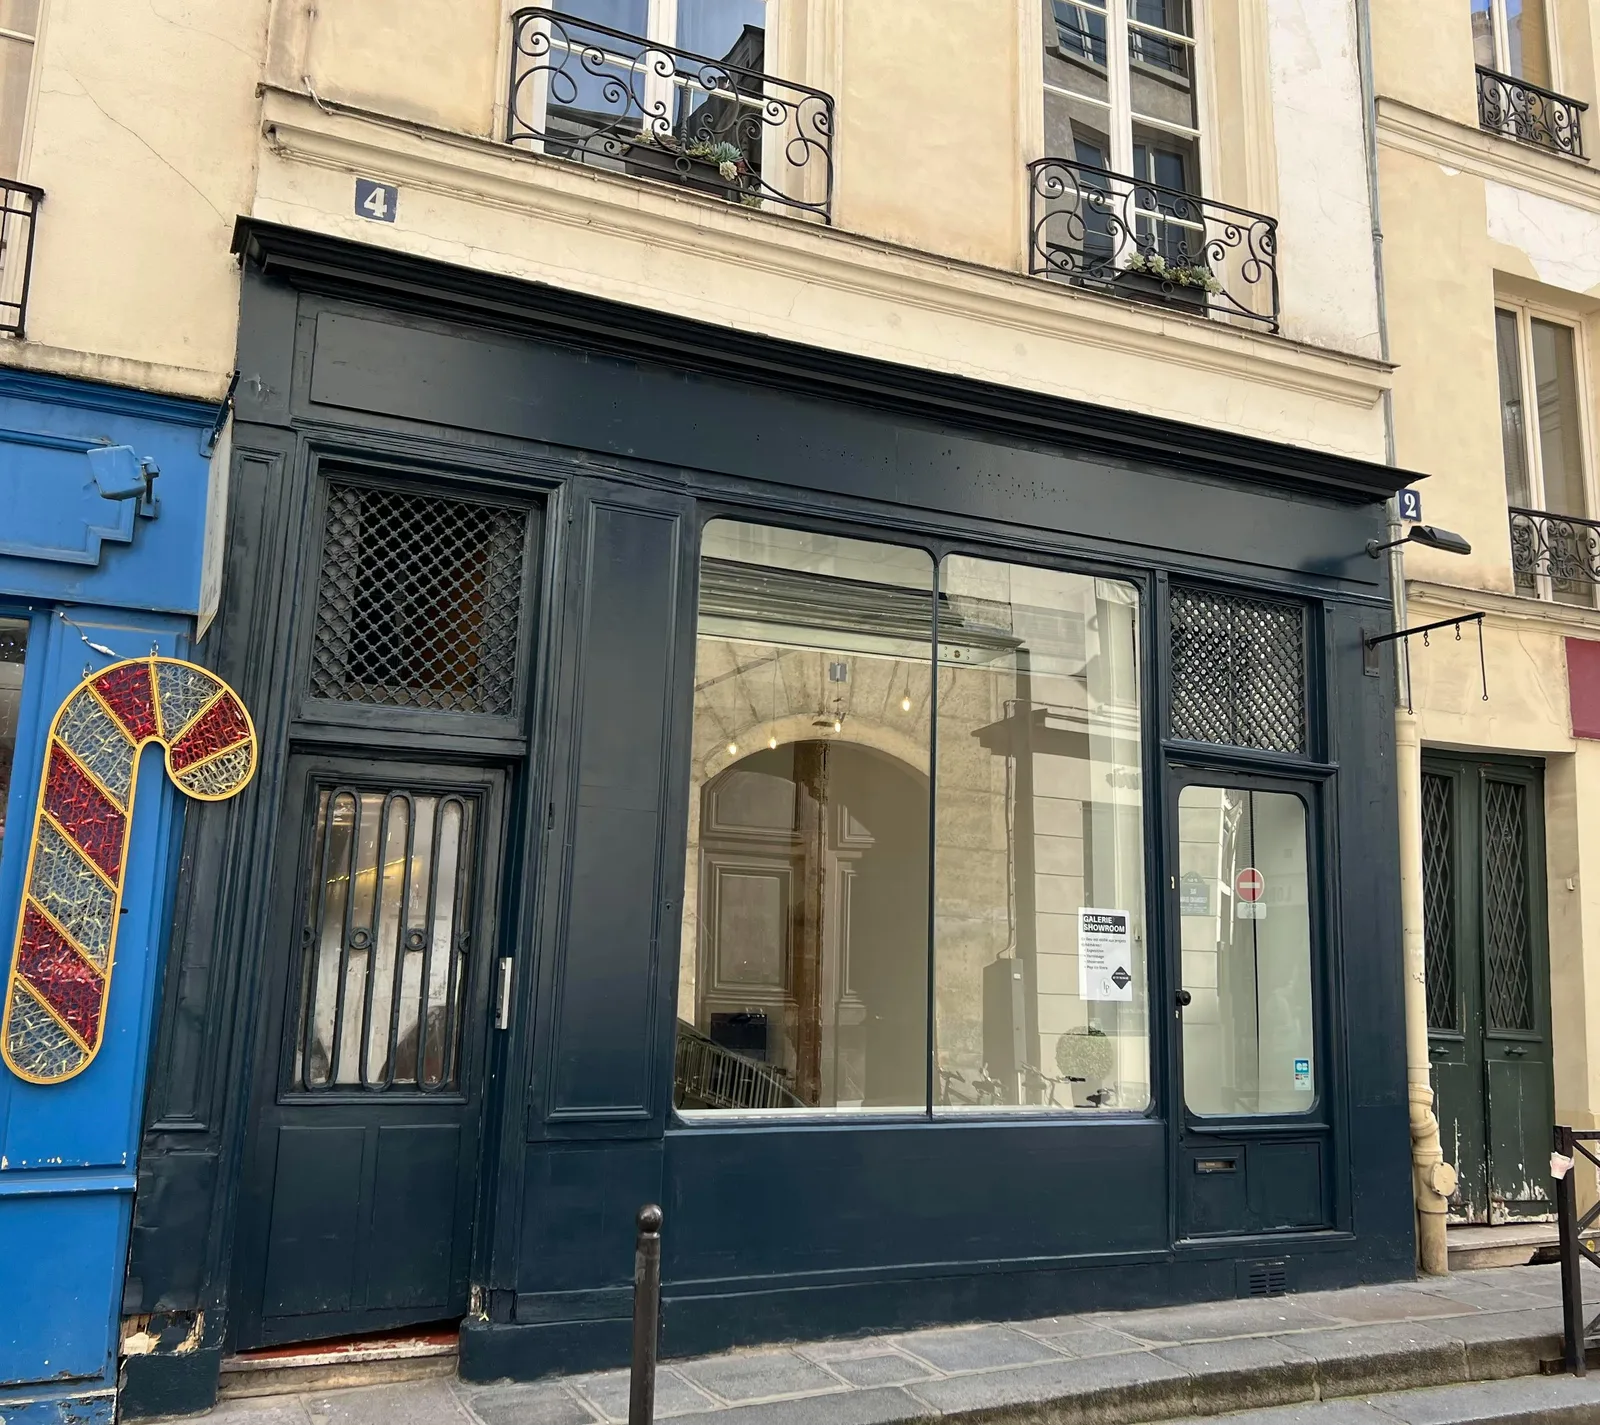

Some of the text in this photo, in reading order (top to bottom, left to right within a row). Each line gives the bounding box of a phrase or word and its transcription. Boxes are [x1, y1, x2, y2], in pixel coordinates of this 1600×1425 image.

[363, 187, 388, 218] 4
[1404, 493, 1417, 517] 2
[1083, 915, 1113, 924] GALERIE
[1083, 923, 1125, 933] SHOWROOM
